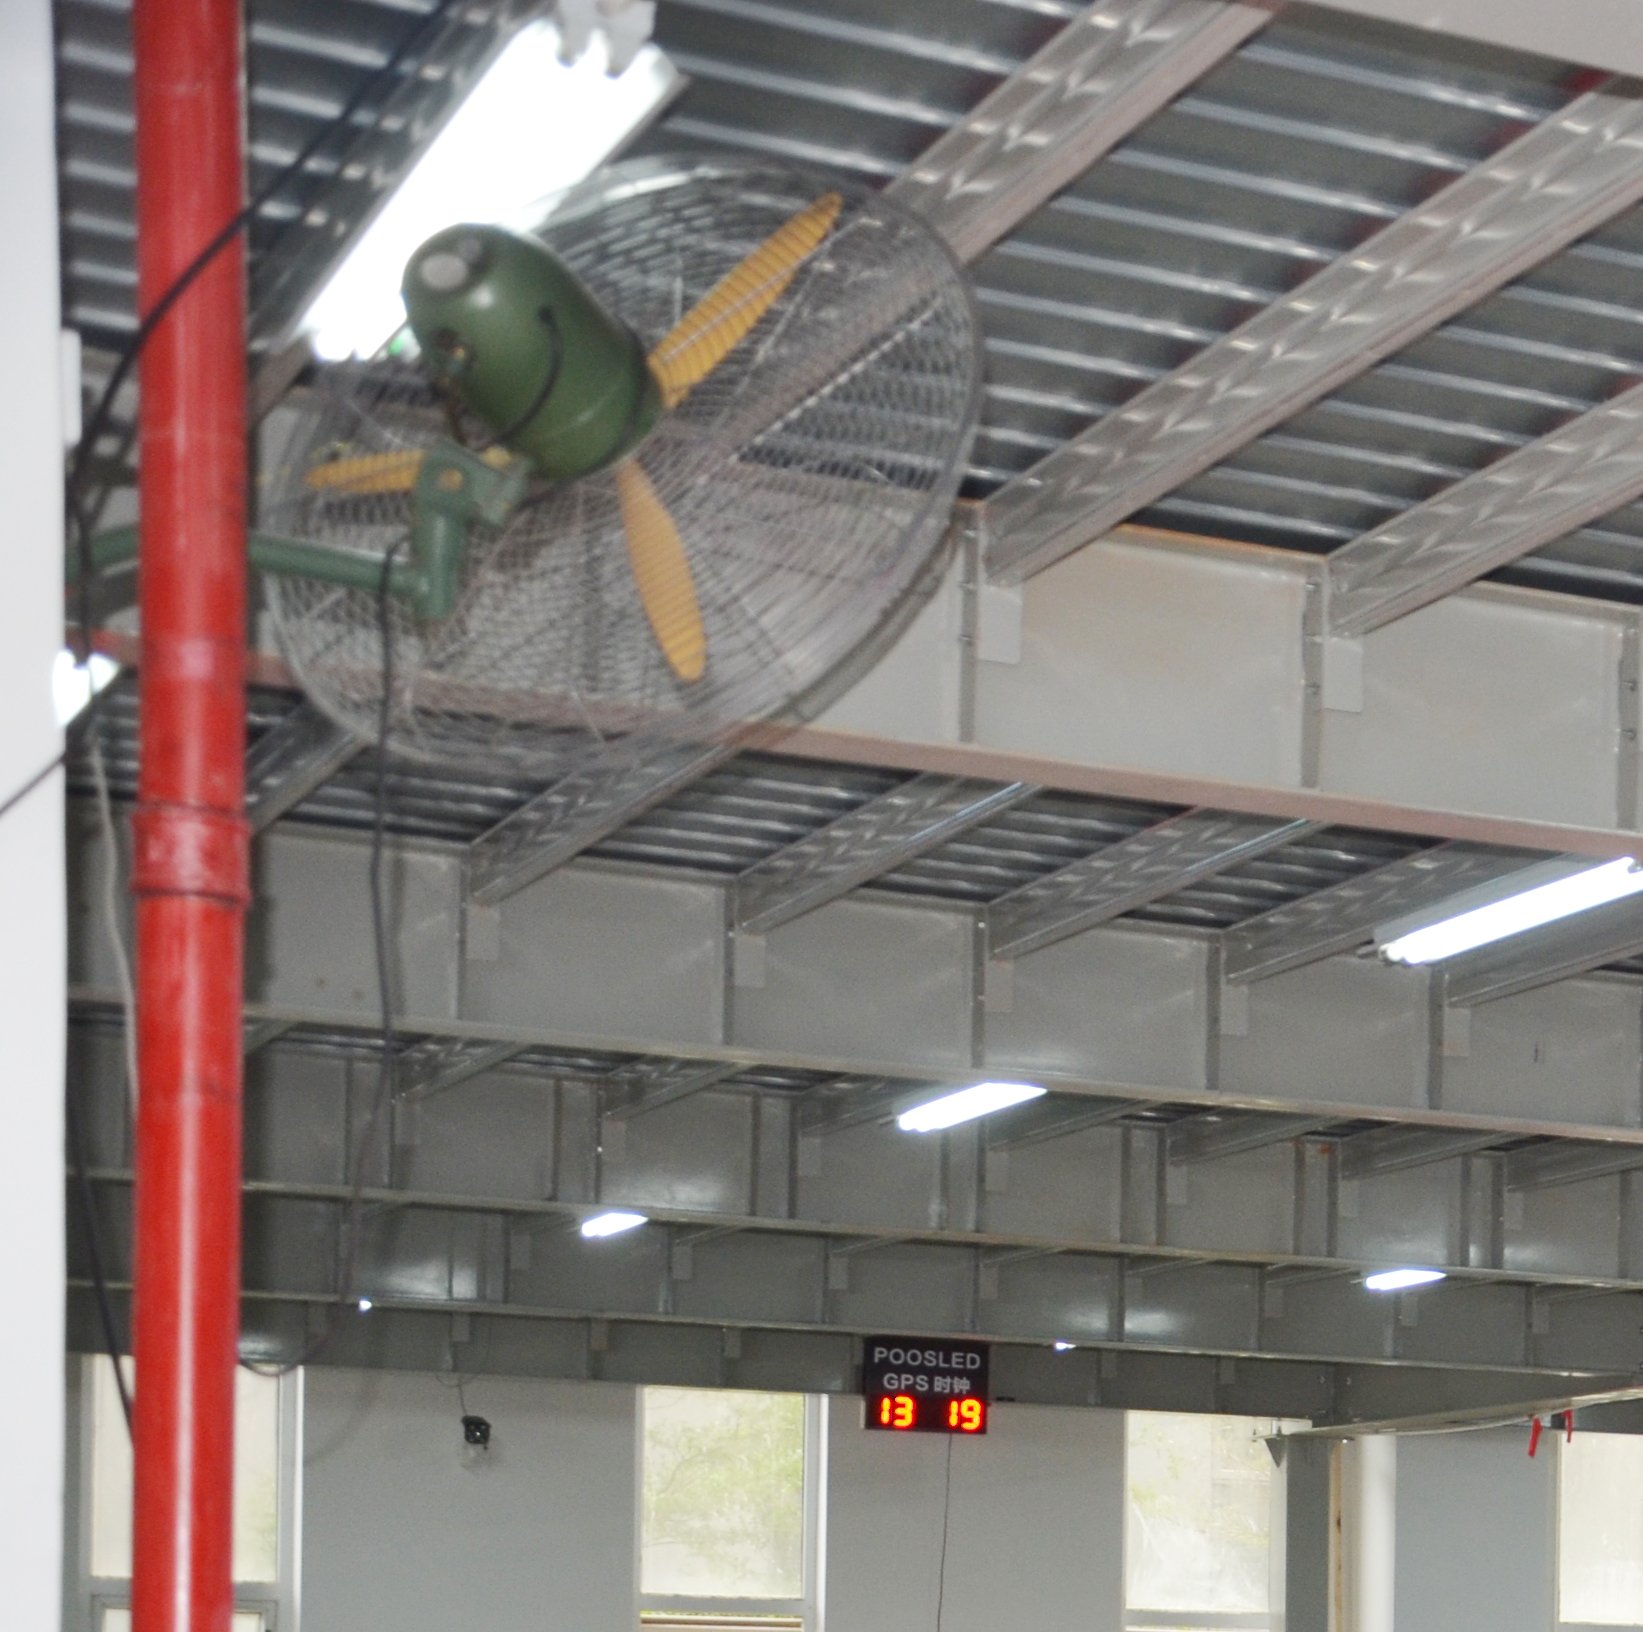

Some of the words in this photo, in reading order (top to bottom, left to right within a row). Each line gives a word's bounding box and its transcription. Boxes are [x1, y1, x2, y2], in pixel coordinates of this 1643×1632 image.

[874, 1347, 981, 1369] POOSLED
[883, 1373, 929, 1391] GPS
[934, 1376, 971, 1394] 时钟
[881, 1396, 914, 1427] 13
[949, 1399, 981, 1430] 19
